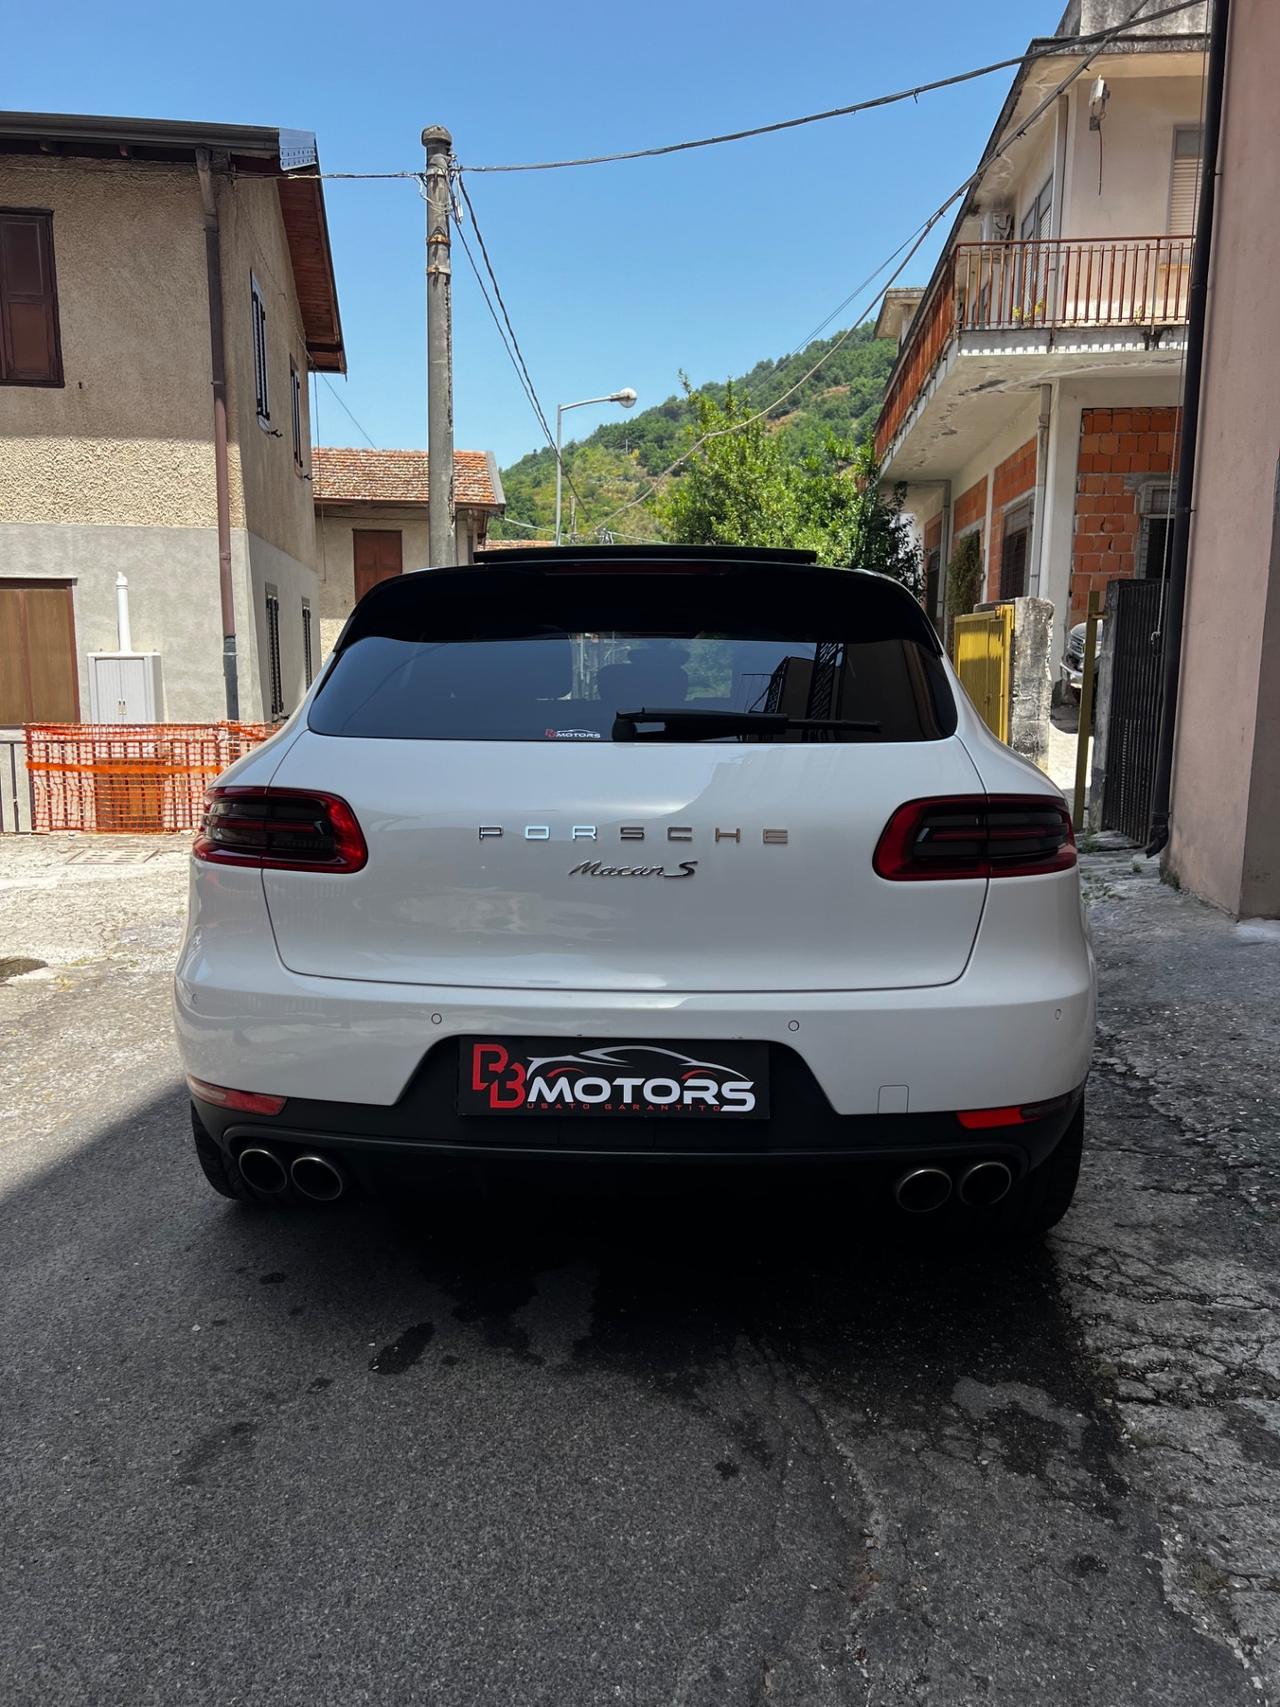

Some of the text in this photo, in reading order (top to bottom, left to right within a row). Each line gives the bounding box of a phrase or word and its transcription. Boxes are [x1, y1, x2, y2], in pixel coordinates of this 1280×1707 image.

[479, 825, 789, 844] PORSCHE
[568, 859, 699, 878] Macan S
[527, 1076, 756, 1112] MOTORS
[604, 1103, 720, 1112] GARANTITO
